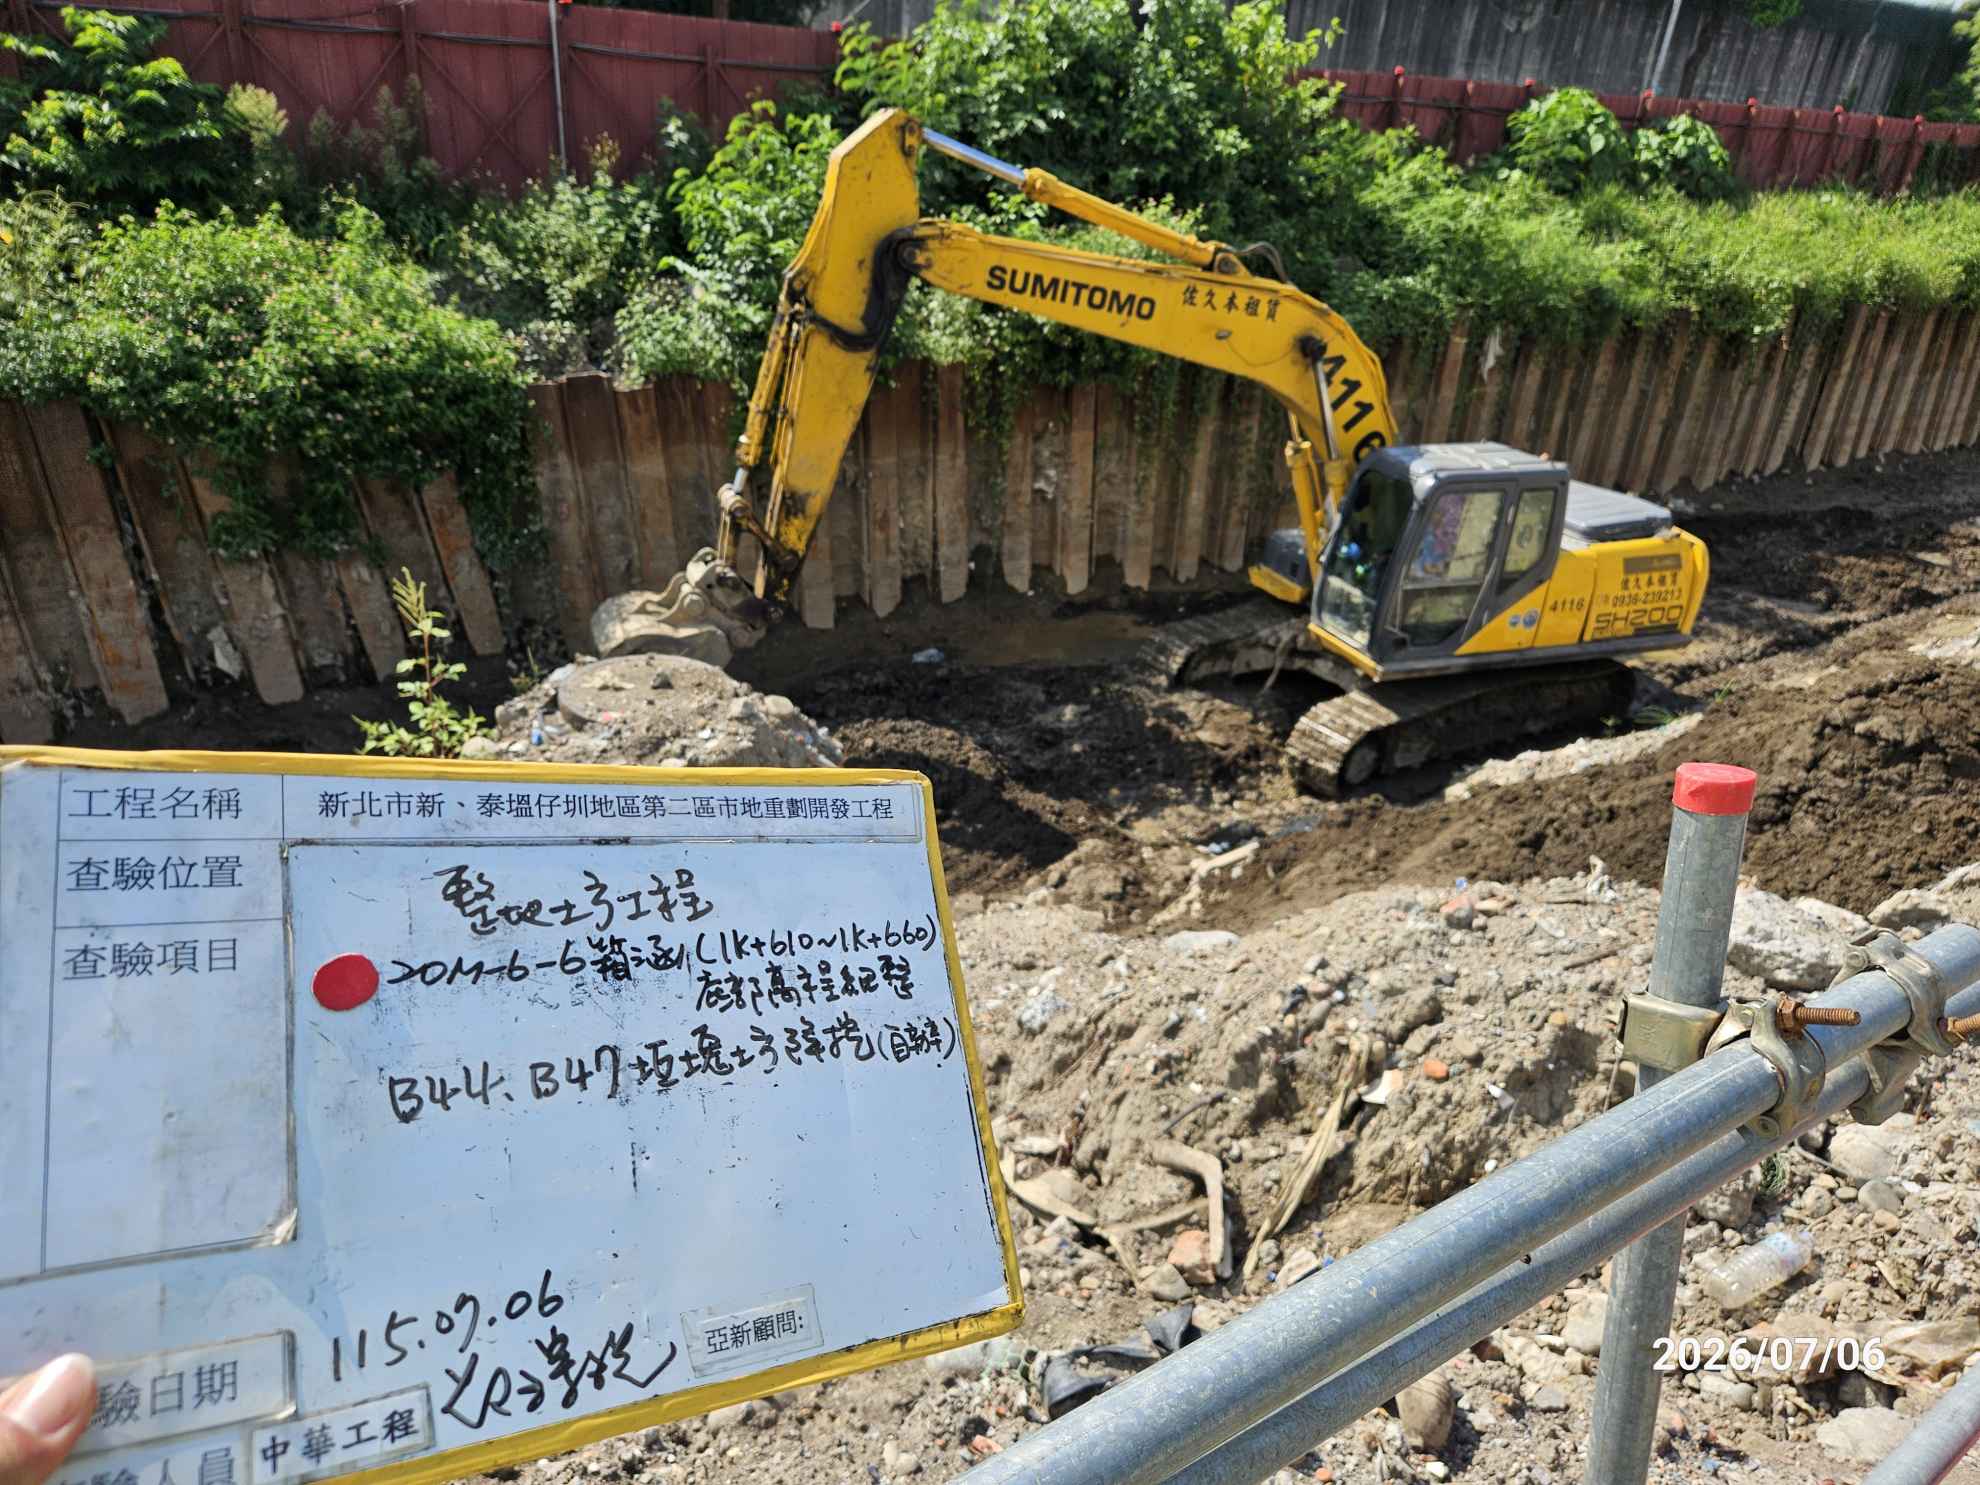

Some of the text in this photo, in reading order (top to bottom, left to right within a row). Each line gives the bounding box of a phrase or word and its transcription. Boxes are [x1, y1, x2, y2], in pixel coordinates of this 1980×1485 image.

[986, 265, 1157, 321] SUMITOMO
[1182, 284, 1281, 322] 佐久本租賃
[1593, 605, 1684, 630] SH200
[68, 786, 243, 820] 工程名稱
[318, 791, 894, 820] 新北市新、泰塭仔圳地區第二區市地重劃開發工程
[66, 856, 243, 892] 查驗位置
[62, 938, 238, 980] 查驗項目
[333, 1269, 564, 1380] 115.07.06
[90, 1360, 238, 1427] 驗日期
[261, 1407, 420, 1475] 中華工程
